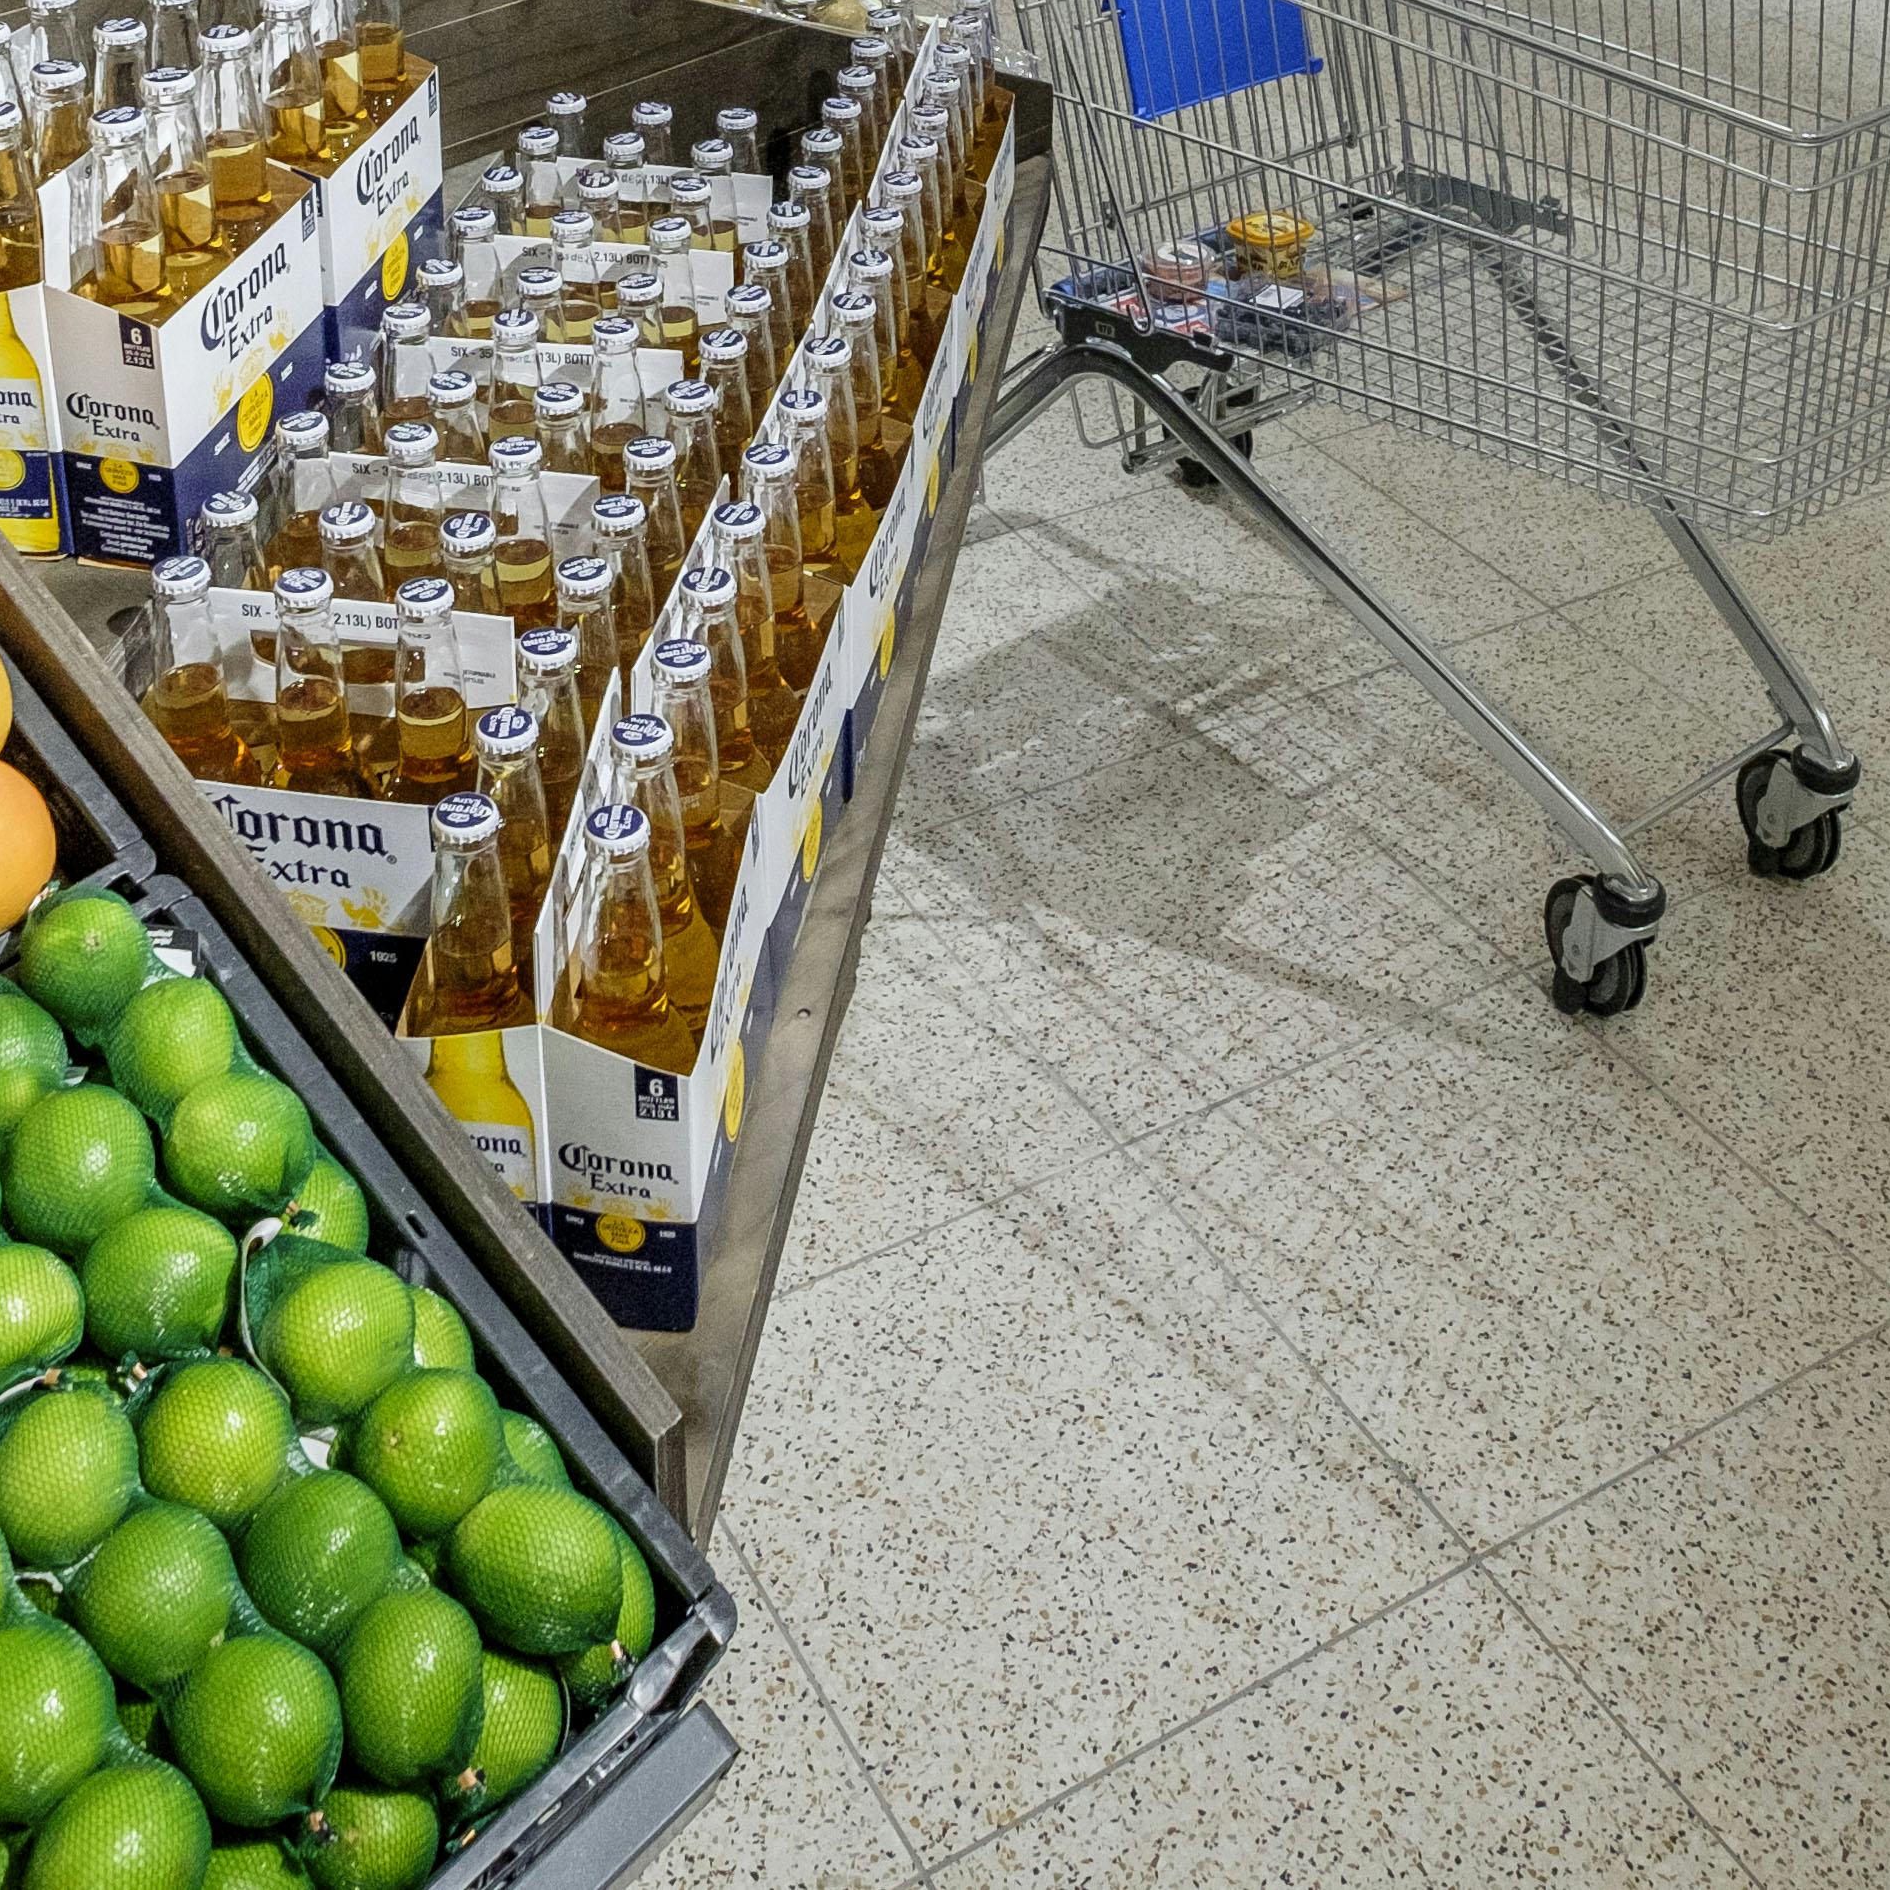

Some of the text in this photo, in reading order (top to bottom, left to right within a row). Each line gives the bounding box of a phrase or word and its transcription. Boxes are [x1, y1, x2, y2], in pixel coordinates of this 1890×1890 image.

[356, 114, 420, 207] Corona
[375, 169, 410, 218] Extra
[200, 241, 292, 352] Corona
[129, 326, 143, 345] 6
[224, 304, 273, 364] Extra
[450, 346, 469, 359] SIX
[65, 391, 156, 426] Corona
[92, 419, 142, 443] Extra
[352, 463, 370, 476] SIX
[869, 487, 906, 600] Corona
[241, 603, 263, 618] SIX
[788, 661, 832, 799] Corona
[440, 802, 493, 819] Corona
[710, 883, 749, 1065] Corona
[649, 1078, 664, 1097] 6
[558, 1141, 674, 1182] Corona
[590, 1172, 651, 1200] Extra
